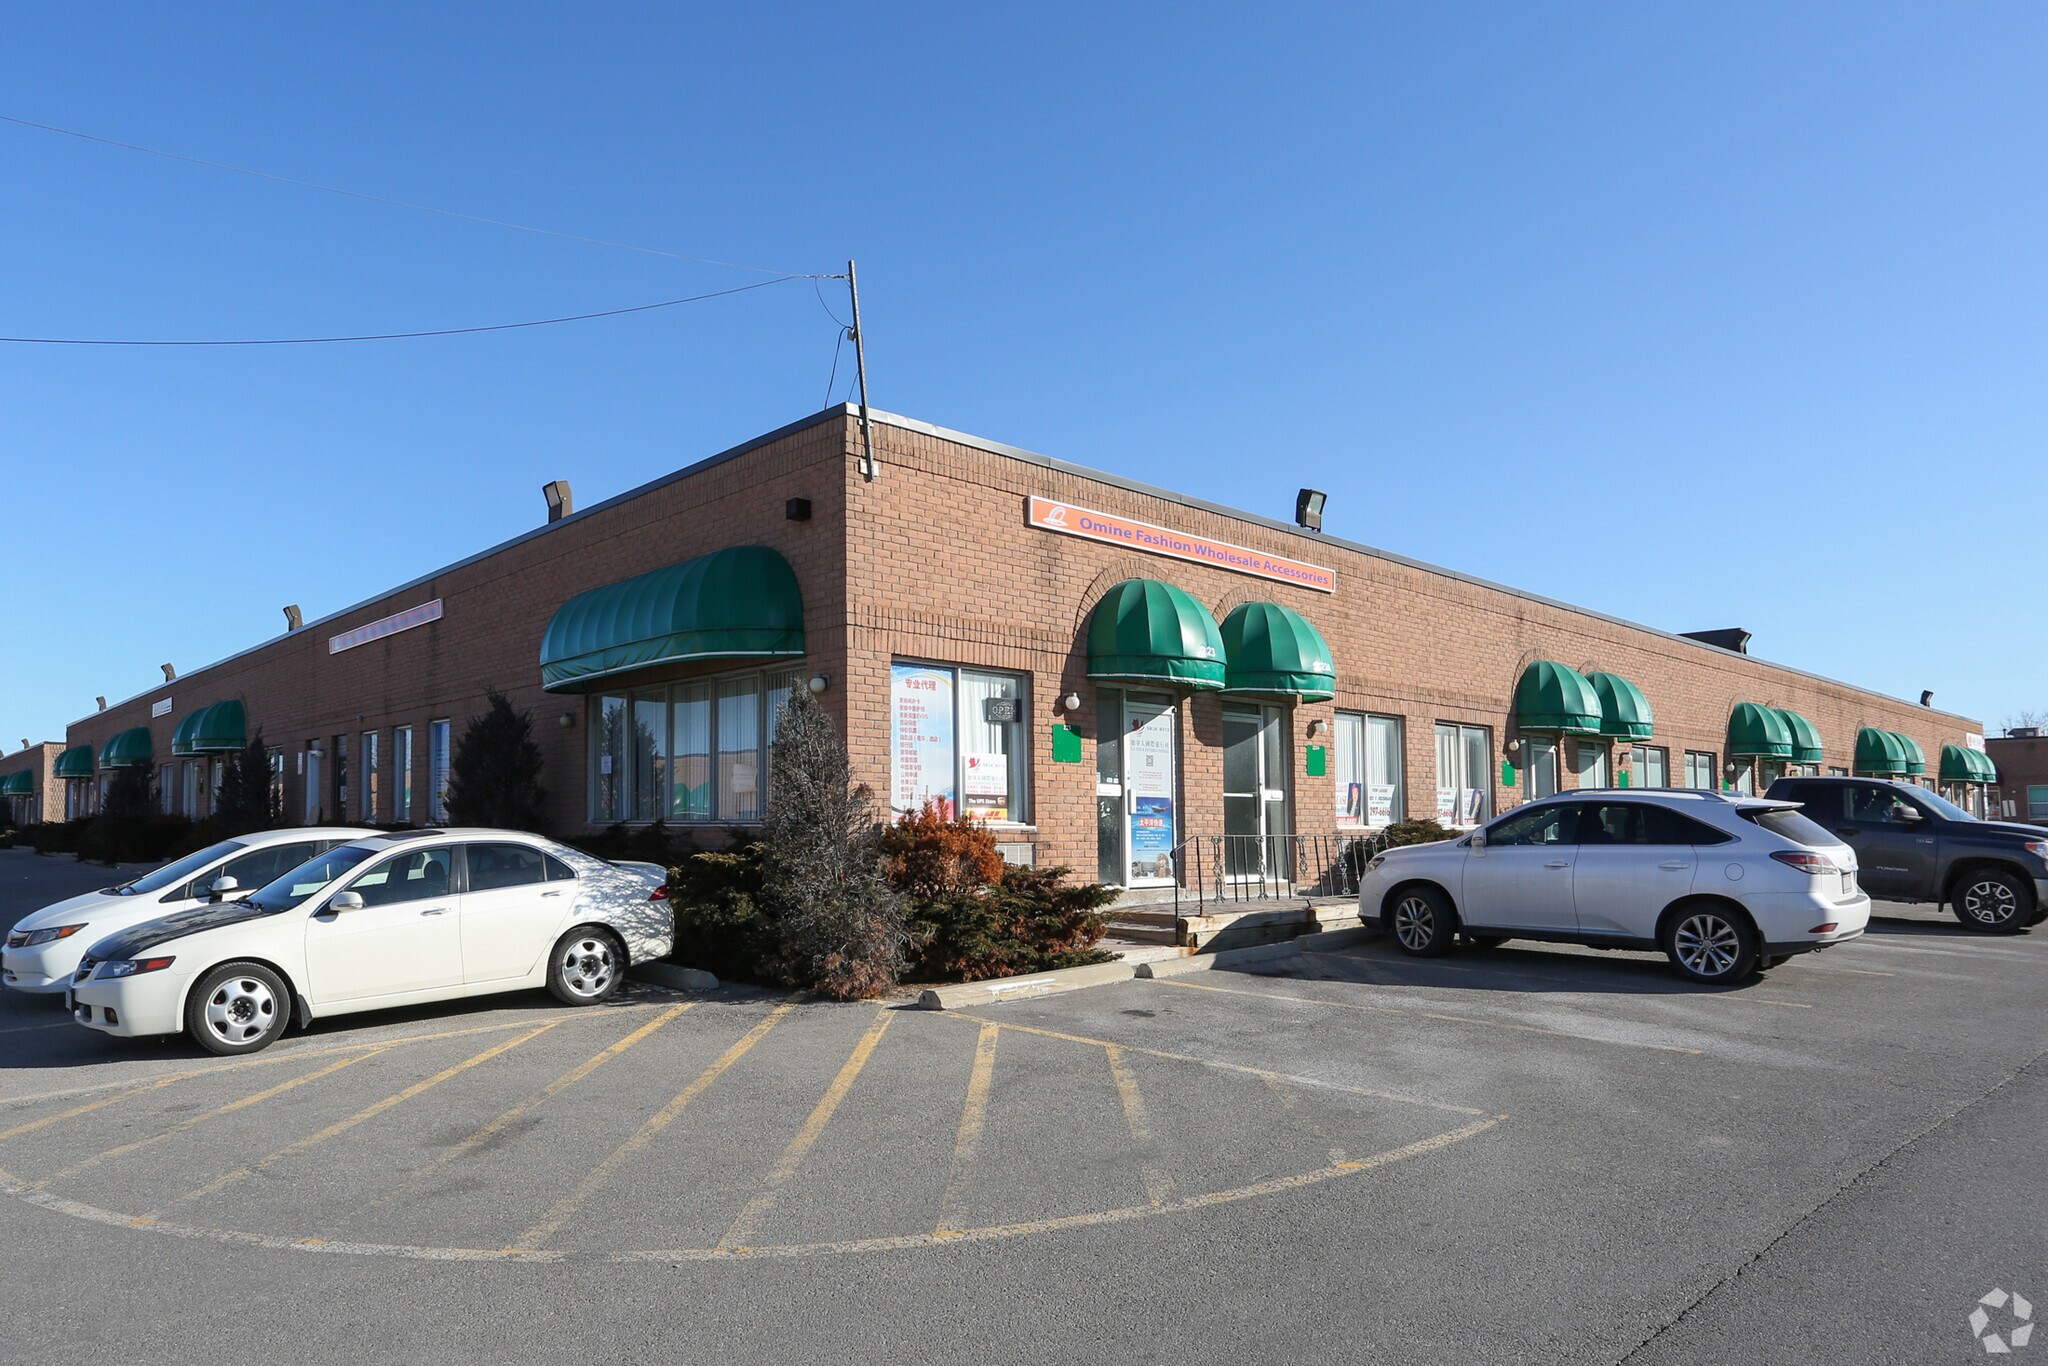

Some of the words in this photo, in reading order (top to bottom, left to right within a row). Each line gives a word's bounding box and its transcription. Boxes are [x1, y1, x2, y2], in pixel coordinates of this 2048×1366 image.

[1079, 517, 1132, 539] Omine
[1136, 530, 1192, 553] Fashion
[1194, 544, 1260, 569] Wholesale
[1263, 560, 1329, 585] Accessories
[905, 678, 937, 691] 专业代理
